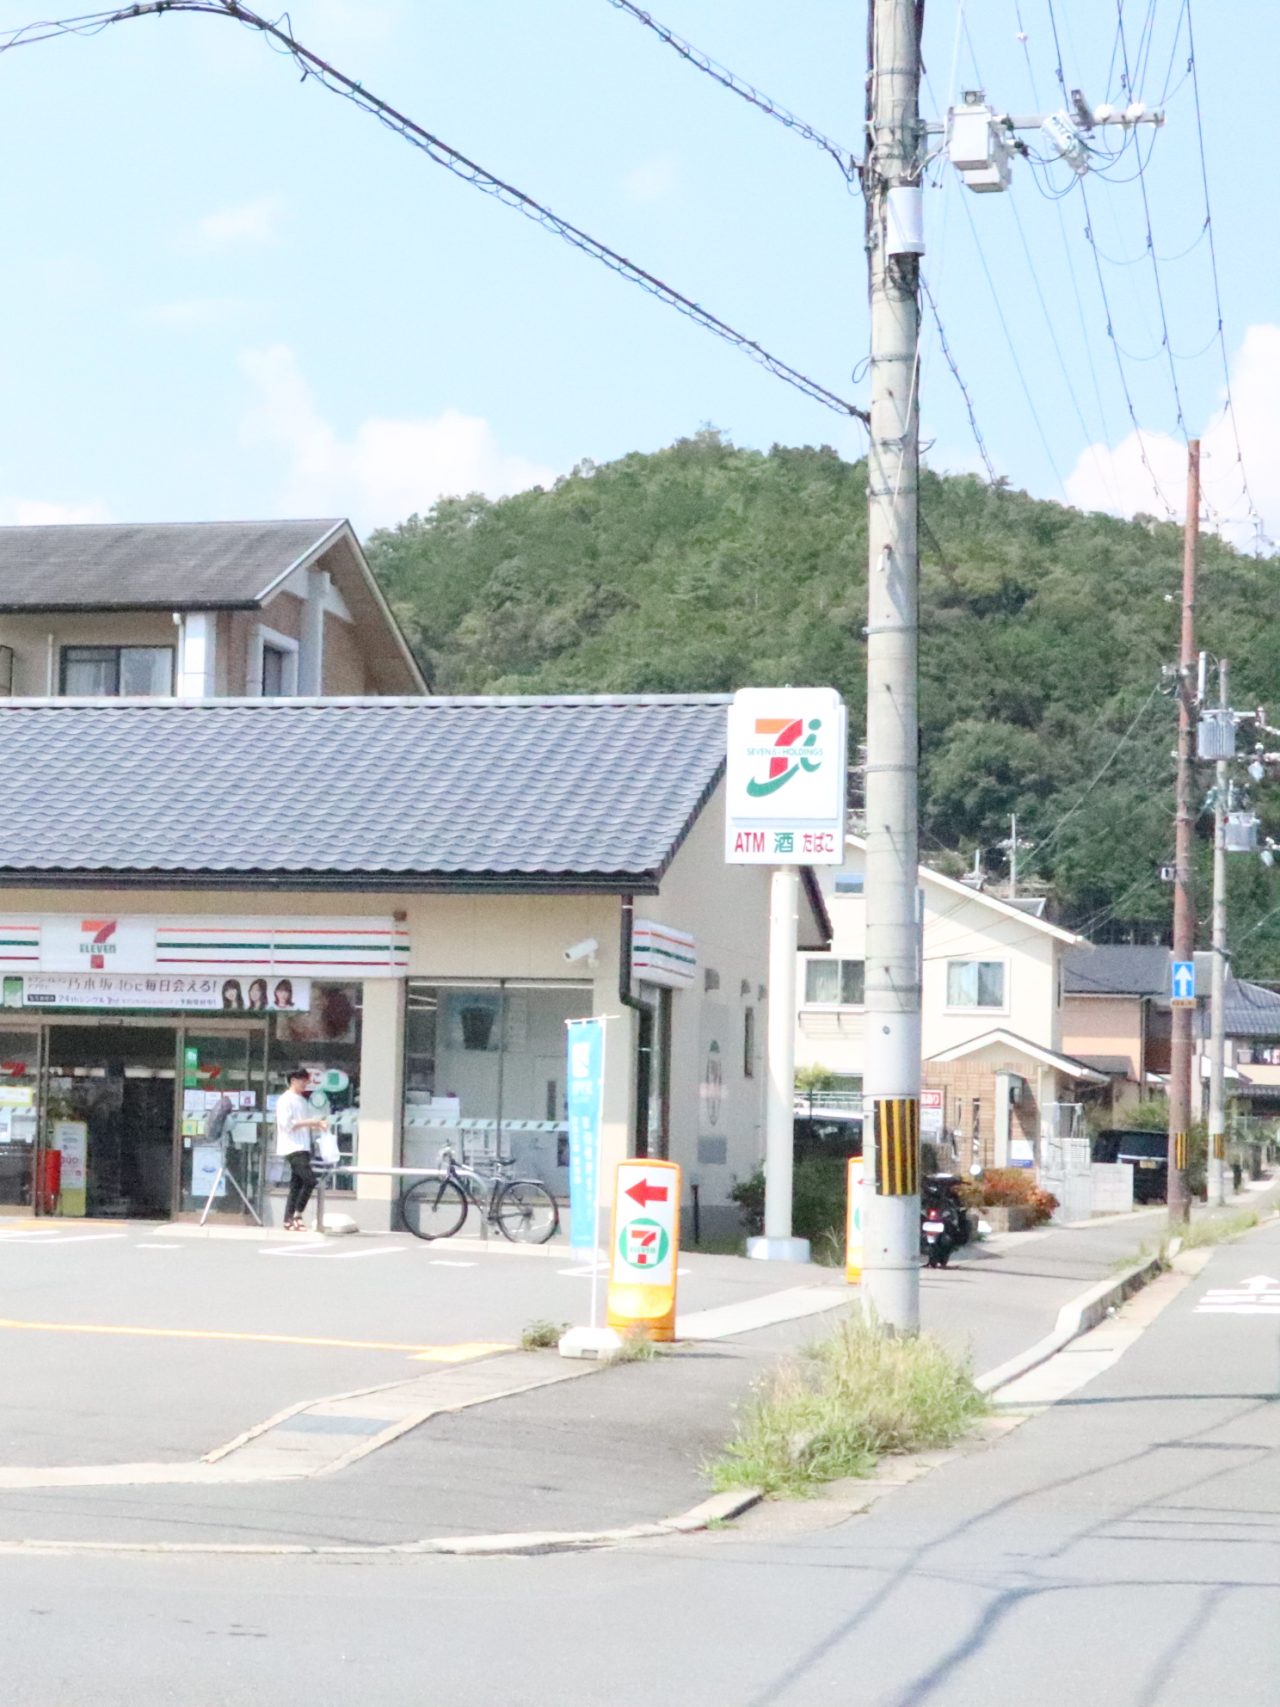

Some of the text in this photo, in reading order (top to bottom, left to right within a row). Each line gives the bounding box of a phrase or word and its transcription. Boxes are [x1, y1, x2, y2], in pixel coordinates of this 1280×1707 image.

[782, 747, 824, 756] HOLDINGS
[734, 832, 765, 853] ATM
[774, 832, 794, 853] 酒
[802, 832, 834, 853] たばこ
[631, 1230, 657, 1265] 7
